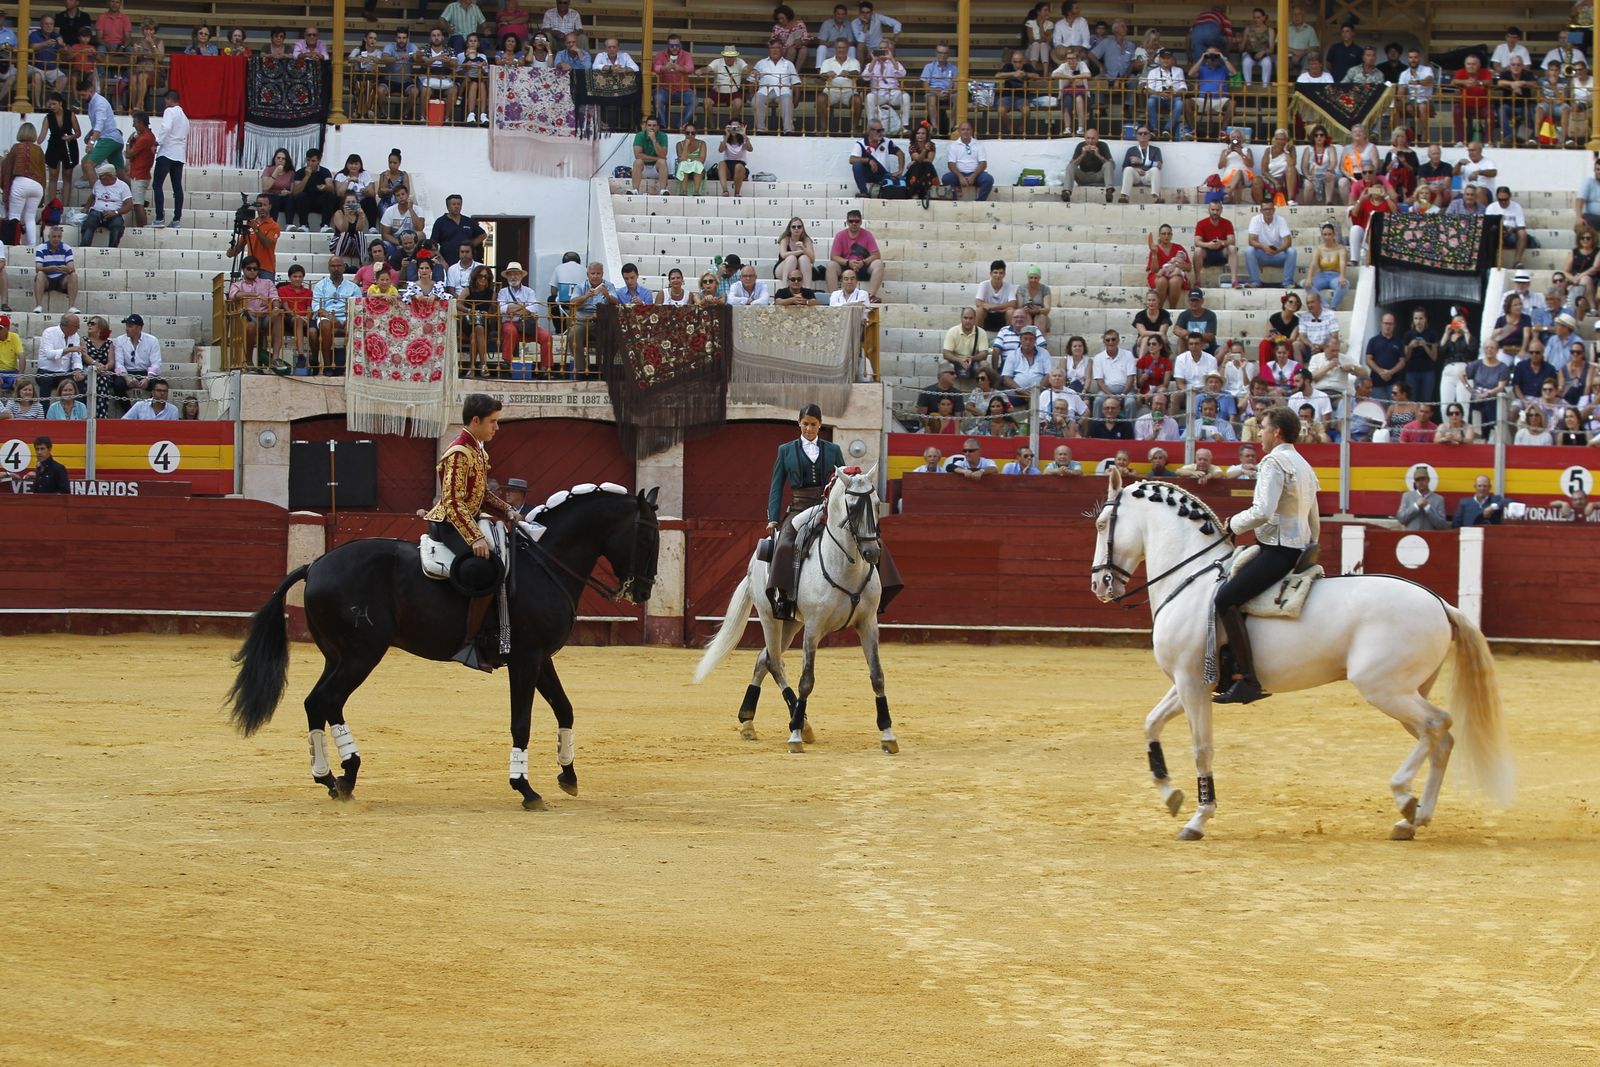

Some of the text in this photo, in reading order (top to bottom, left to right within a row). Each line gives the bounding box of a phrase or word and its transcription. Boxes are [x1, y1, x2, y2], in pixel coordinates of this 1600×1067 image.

[509, 394, 563, 404] SEPTIEMBRE
[566, 395, 578, 404] DE
[581, 395, 601, 405] 1887
[4, 442, 22, 470] 4
[153, 443, 171, 471] 4
[11, 480, 139, 497] VEINARIOS
[1568, 469, 1584, 495] 5
